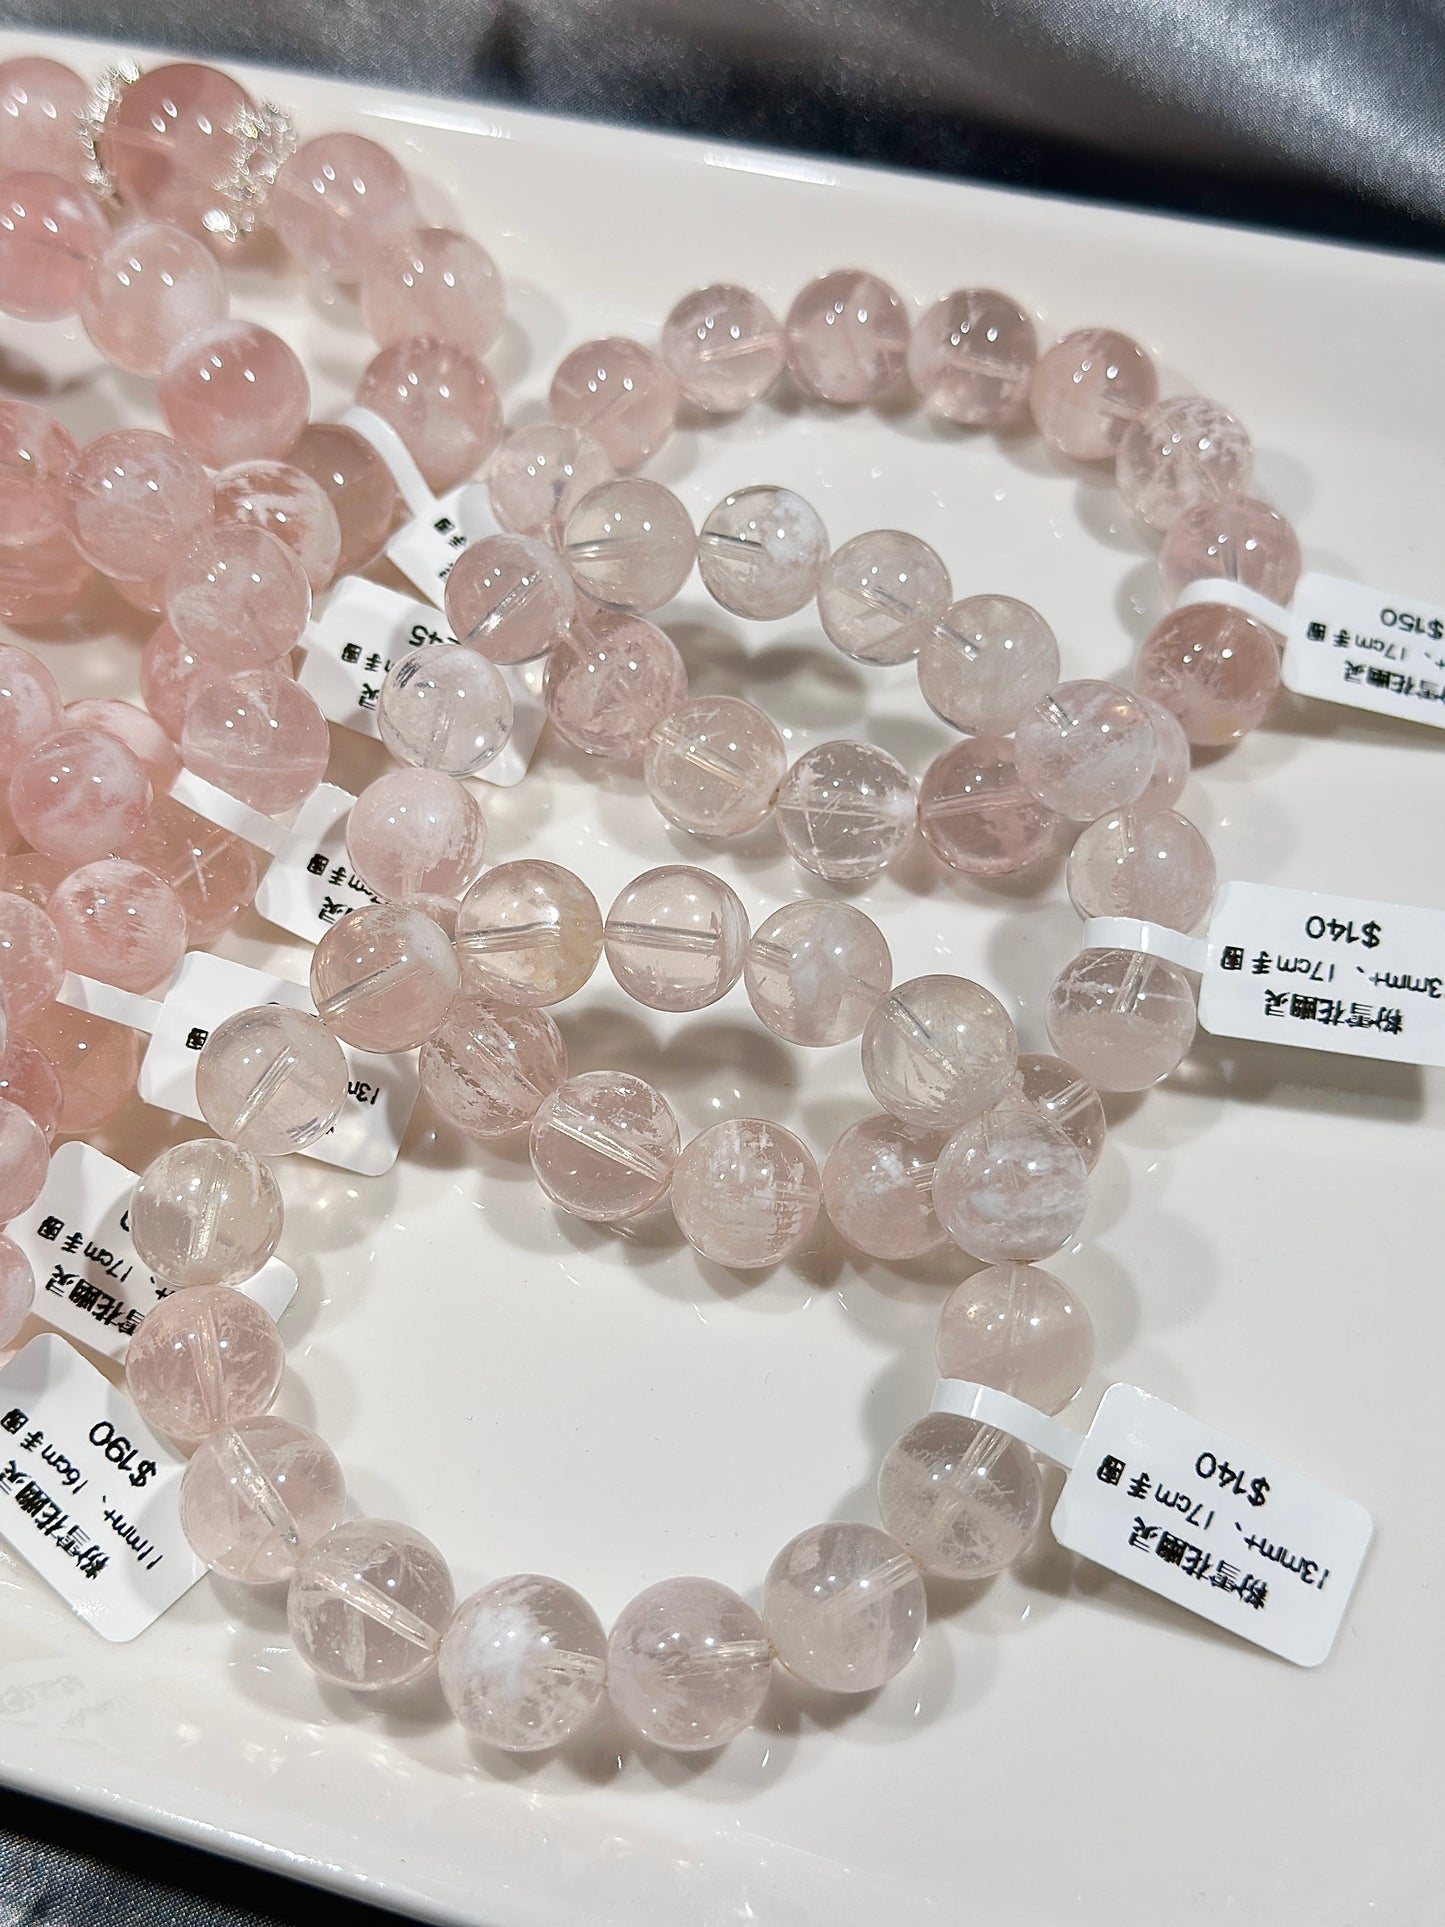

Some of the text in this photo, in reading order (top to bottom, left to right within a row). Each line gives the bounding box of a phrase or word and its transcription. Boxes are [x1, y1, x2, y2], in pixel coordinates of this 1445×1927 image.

[1380, 608, 1445, 640] $150
[1343, 659, 1445, 705] 雪花幽灵
[1305, 915, 1382, 949] $140
[89, 1420, 158, 1487] $190
[1195, 1452, 1271, 1507] $140
